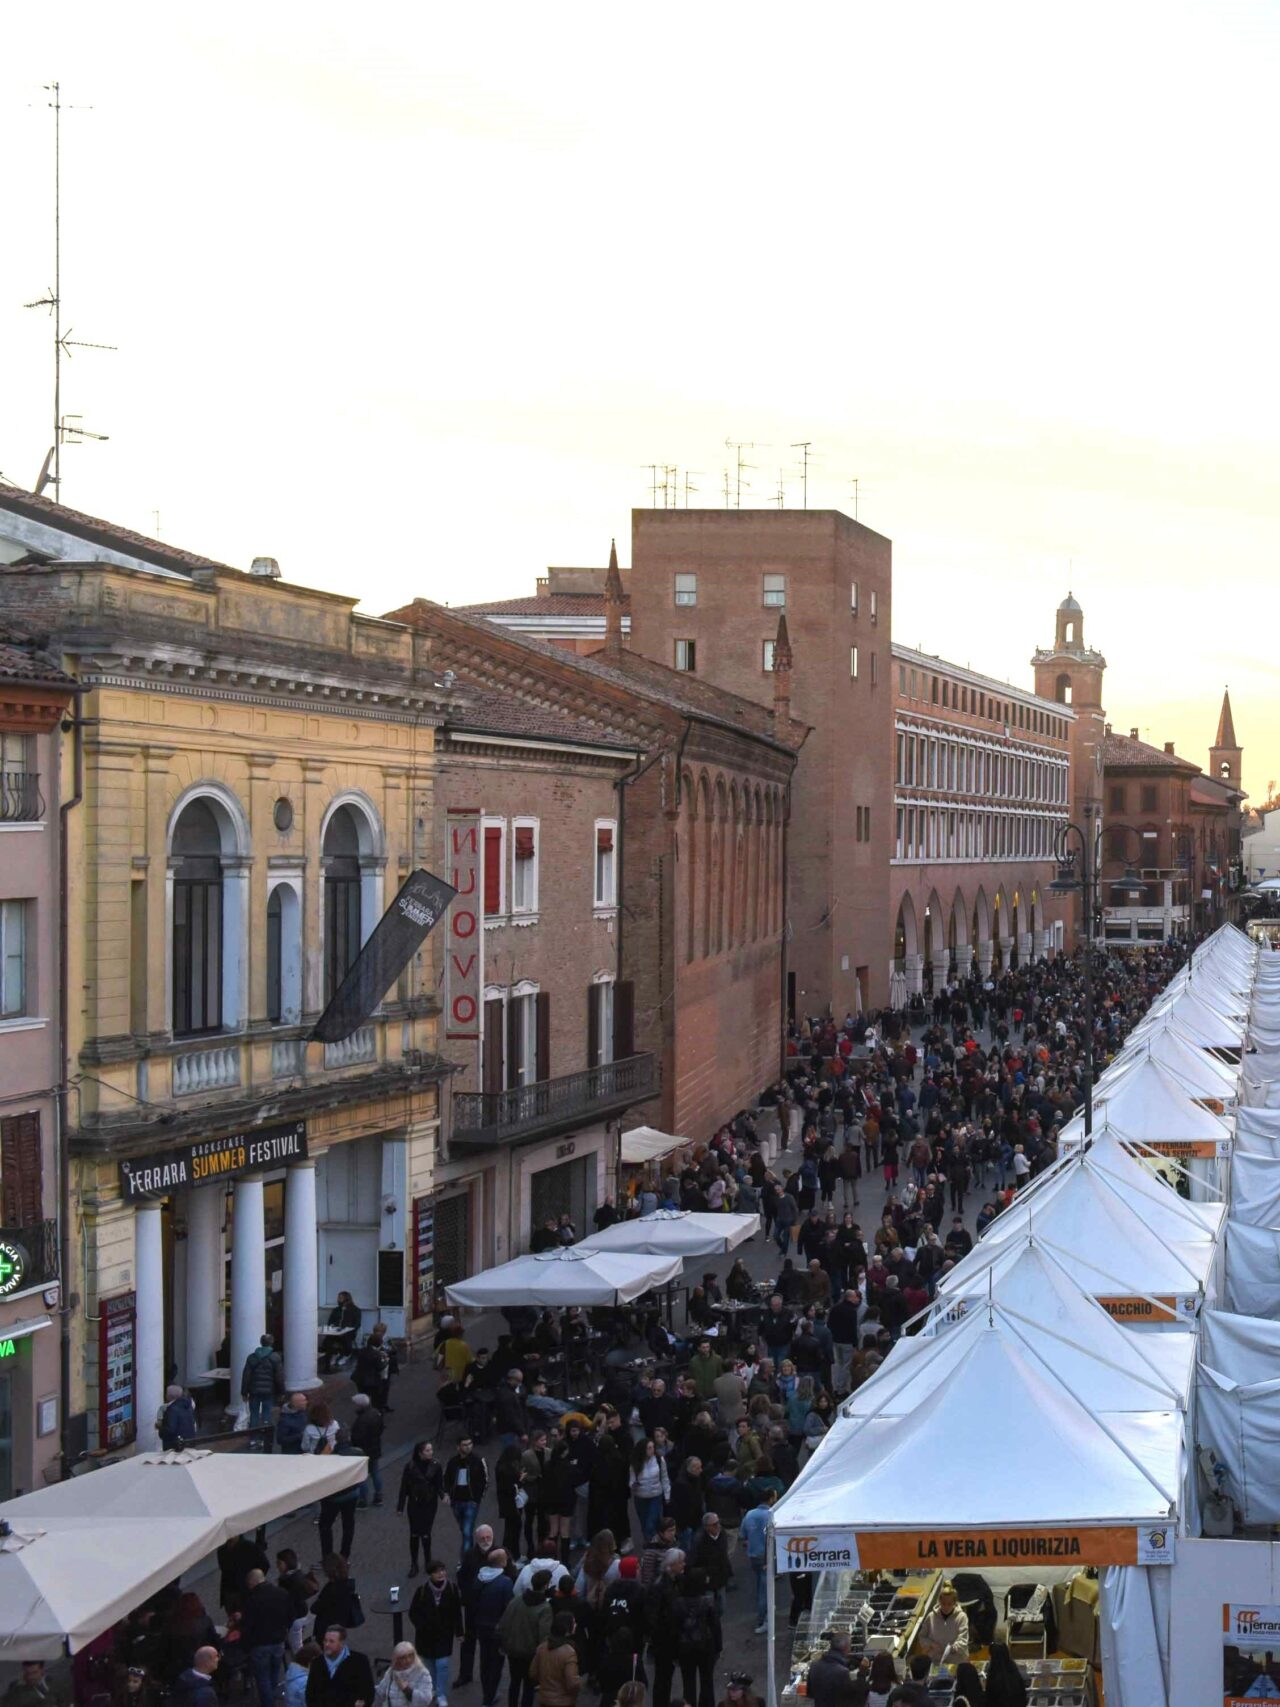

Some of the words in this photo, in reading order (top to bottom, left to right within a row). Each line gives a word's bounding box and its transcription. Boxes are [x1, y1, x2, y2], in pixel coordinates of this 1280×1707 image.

[191, 1136, 245, 1157] BACKSTAGE
[129, 1161, 187, 1194] FERRARA
[192, 1147, 246, 1179] SUMMER
[250, 1134, 300, 1164] FESTIVAL
[917, 1541, 938, 1558] LA
[944, 1540, 987, 1557] VERA
[993, 1537, 1081, 1556] LIQUIRIZIA
